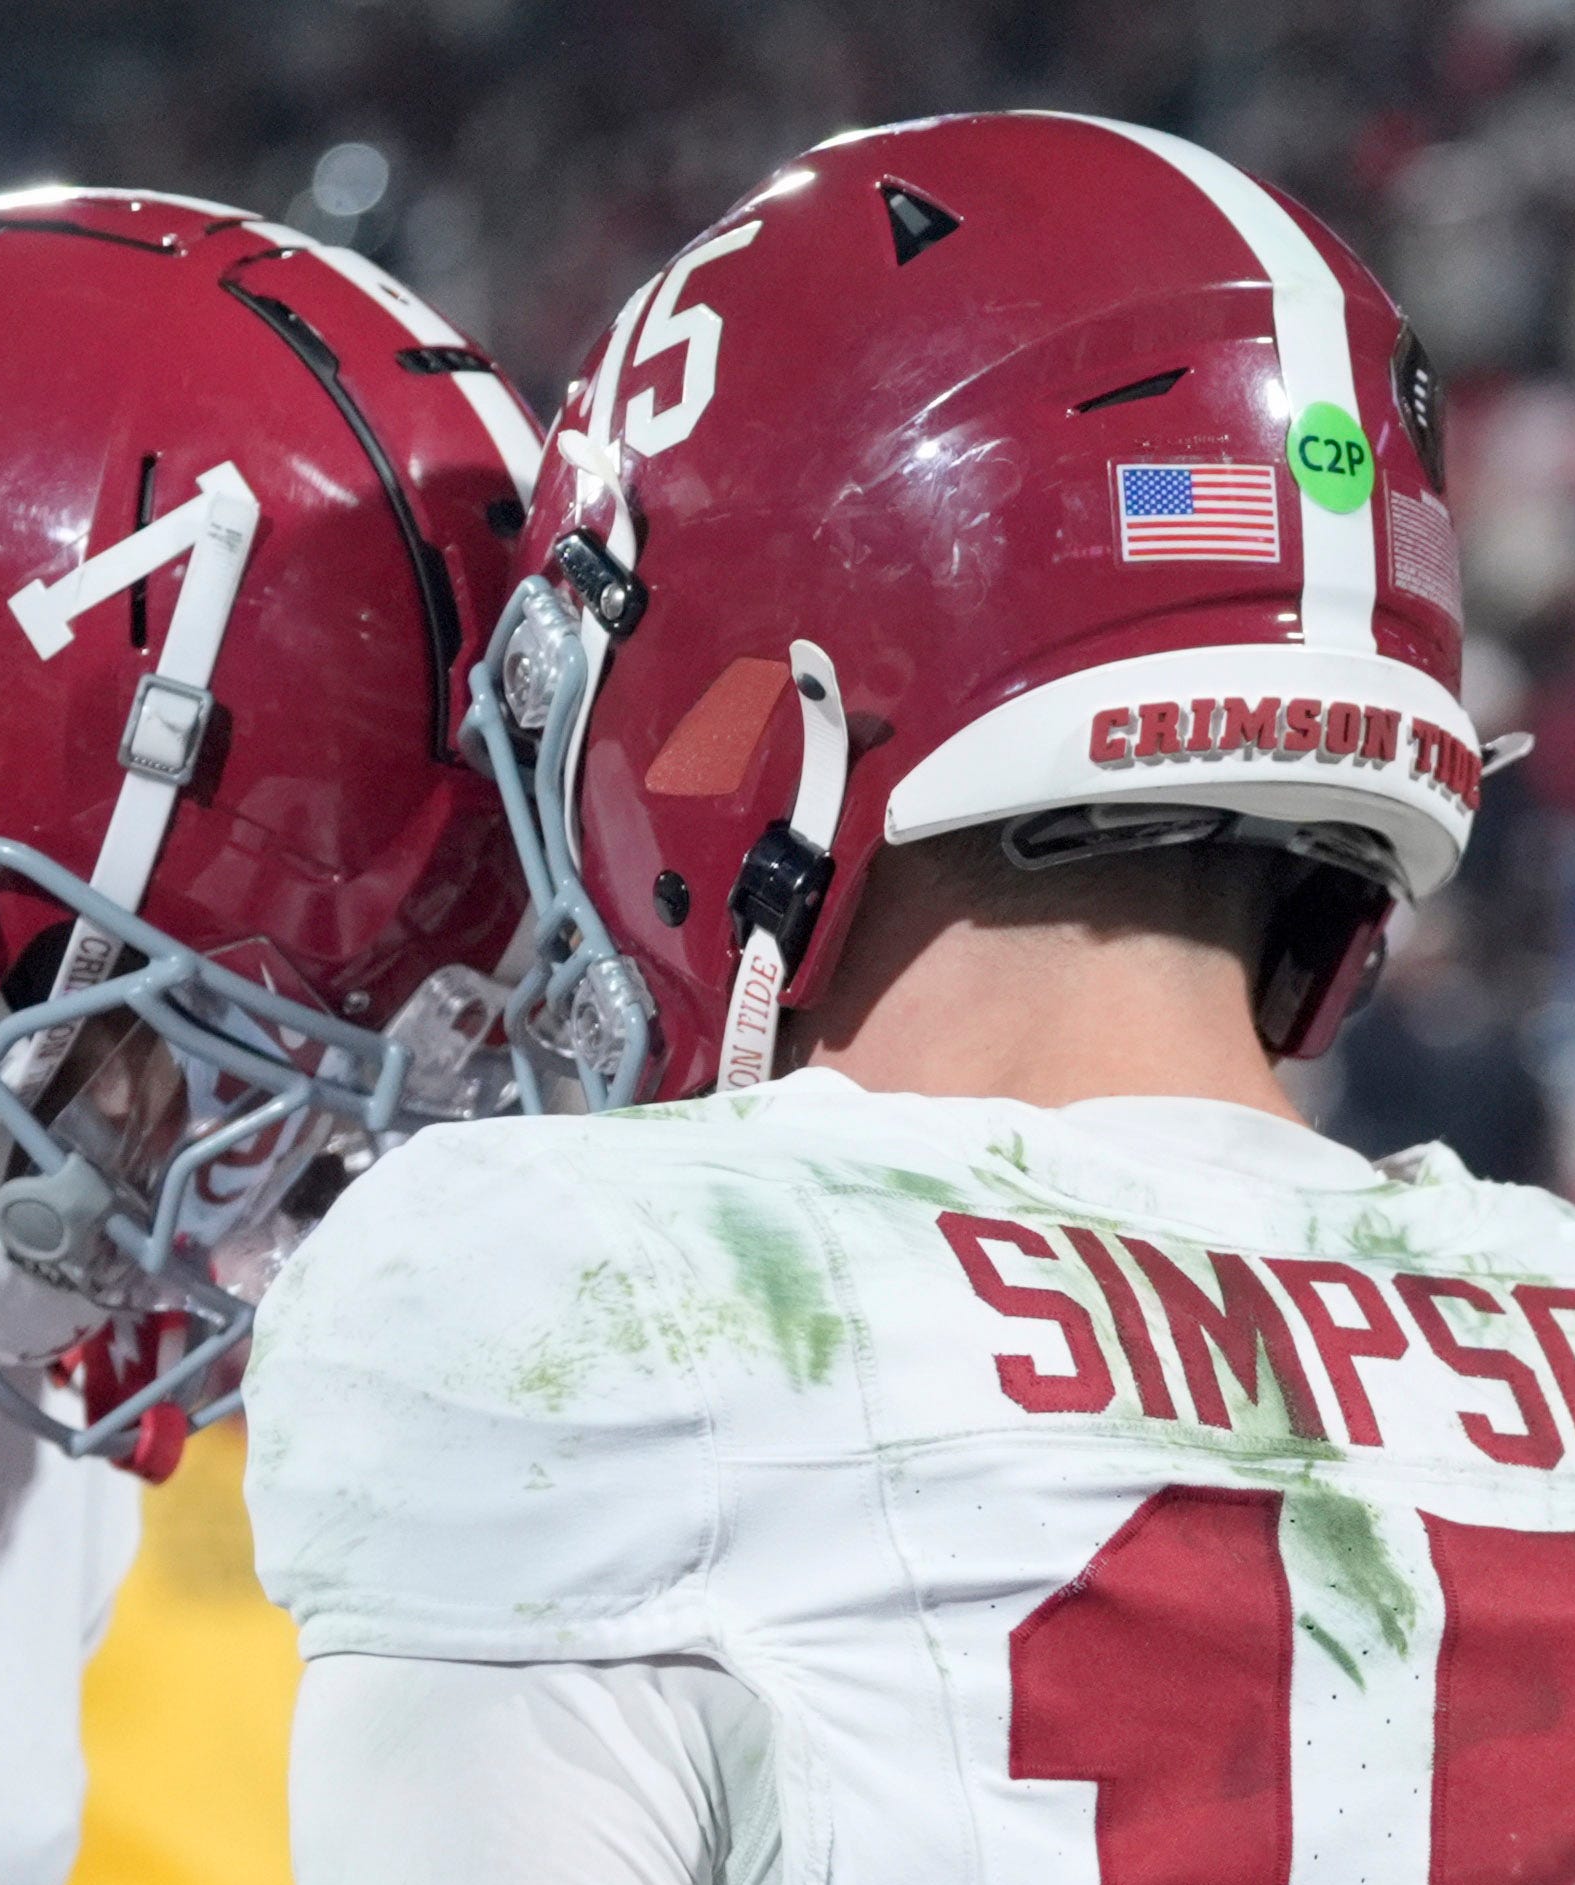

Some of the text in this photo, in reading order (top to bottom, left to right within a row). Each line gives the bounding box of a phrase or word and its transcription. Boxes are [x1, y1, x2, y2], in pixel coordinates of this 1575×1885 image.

[1299, 435, 1366, 478] C2P
[1089, 697, 1484, 811] CRIMSON TIDE
[737, 955, 778, 1035] TIDE
